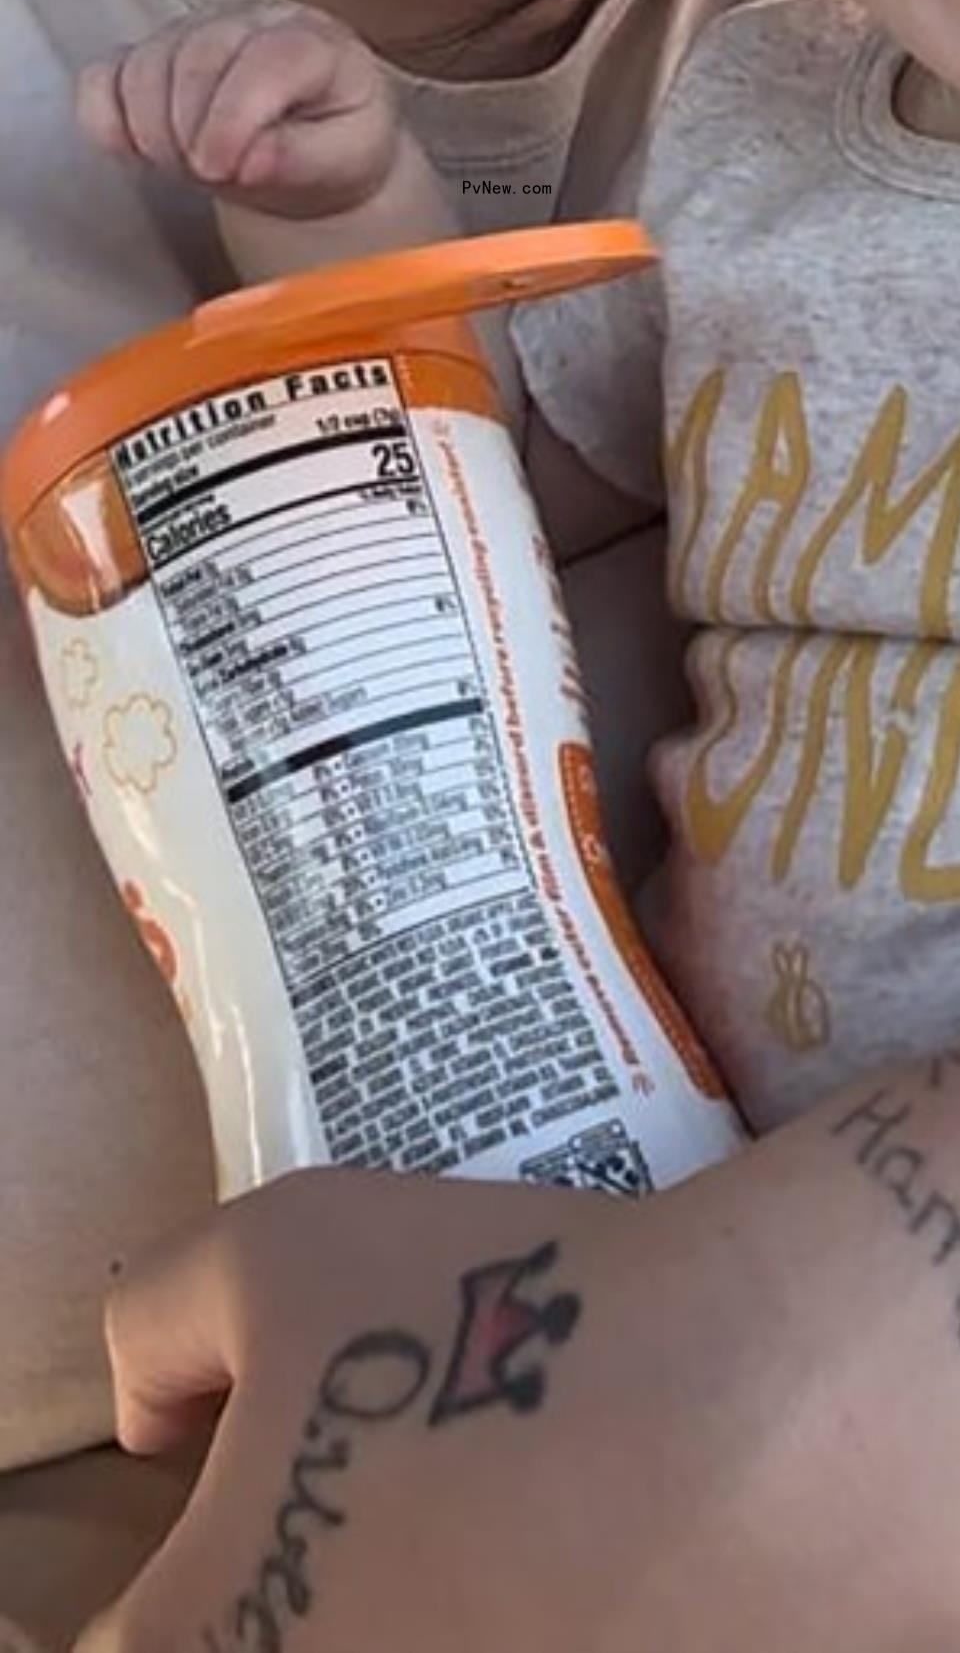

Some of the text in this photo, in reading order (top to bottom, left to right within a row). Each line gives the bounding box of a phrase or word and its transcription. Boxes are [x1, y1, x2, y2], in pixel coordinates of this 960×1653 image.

[115, 361, 389, 467] Nutrition Facts
[372, 442, 415, 478] 25
[146, 503, 232, 561] Calories
[206, 1327, 430, 1653] Quee
